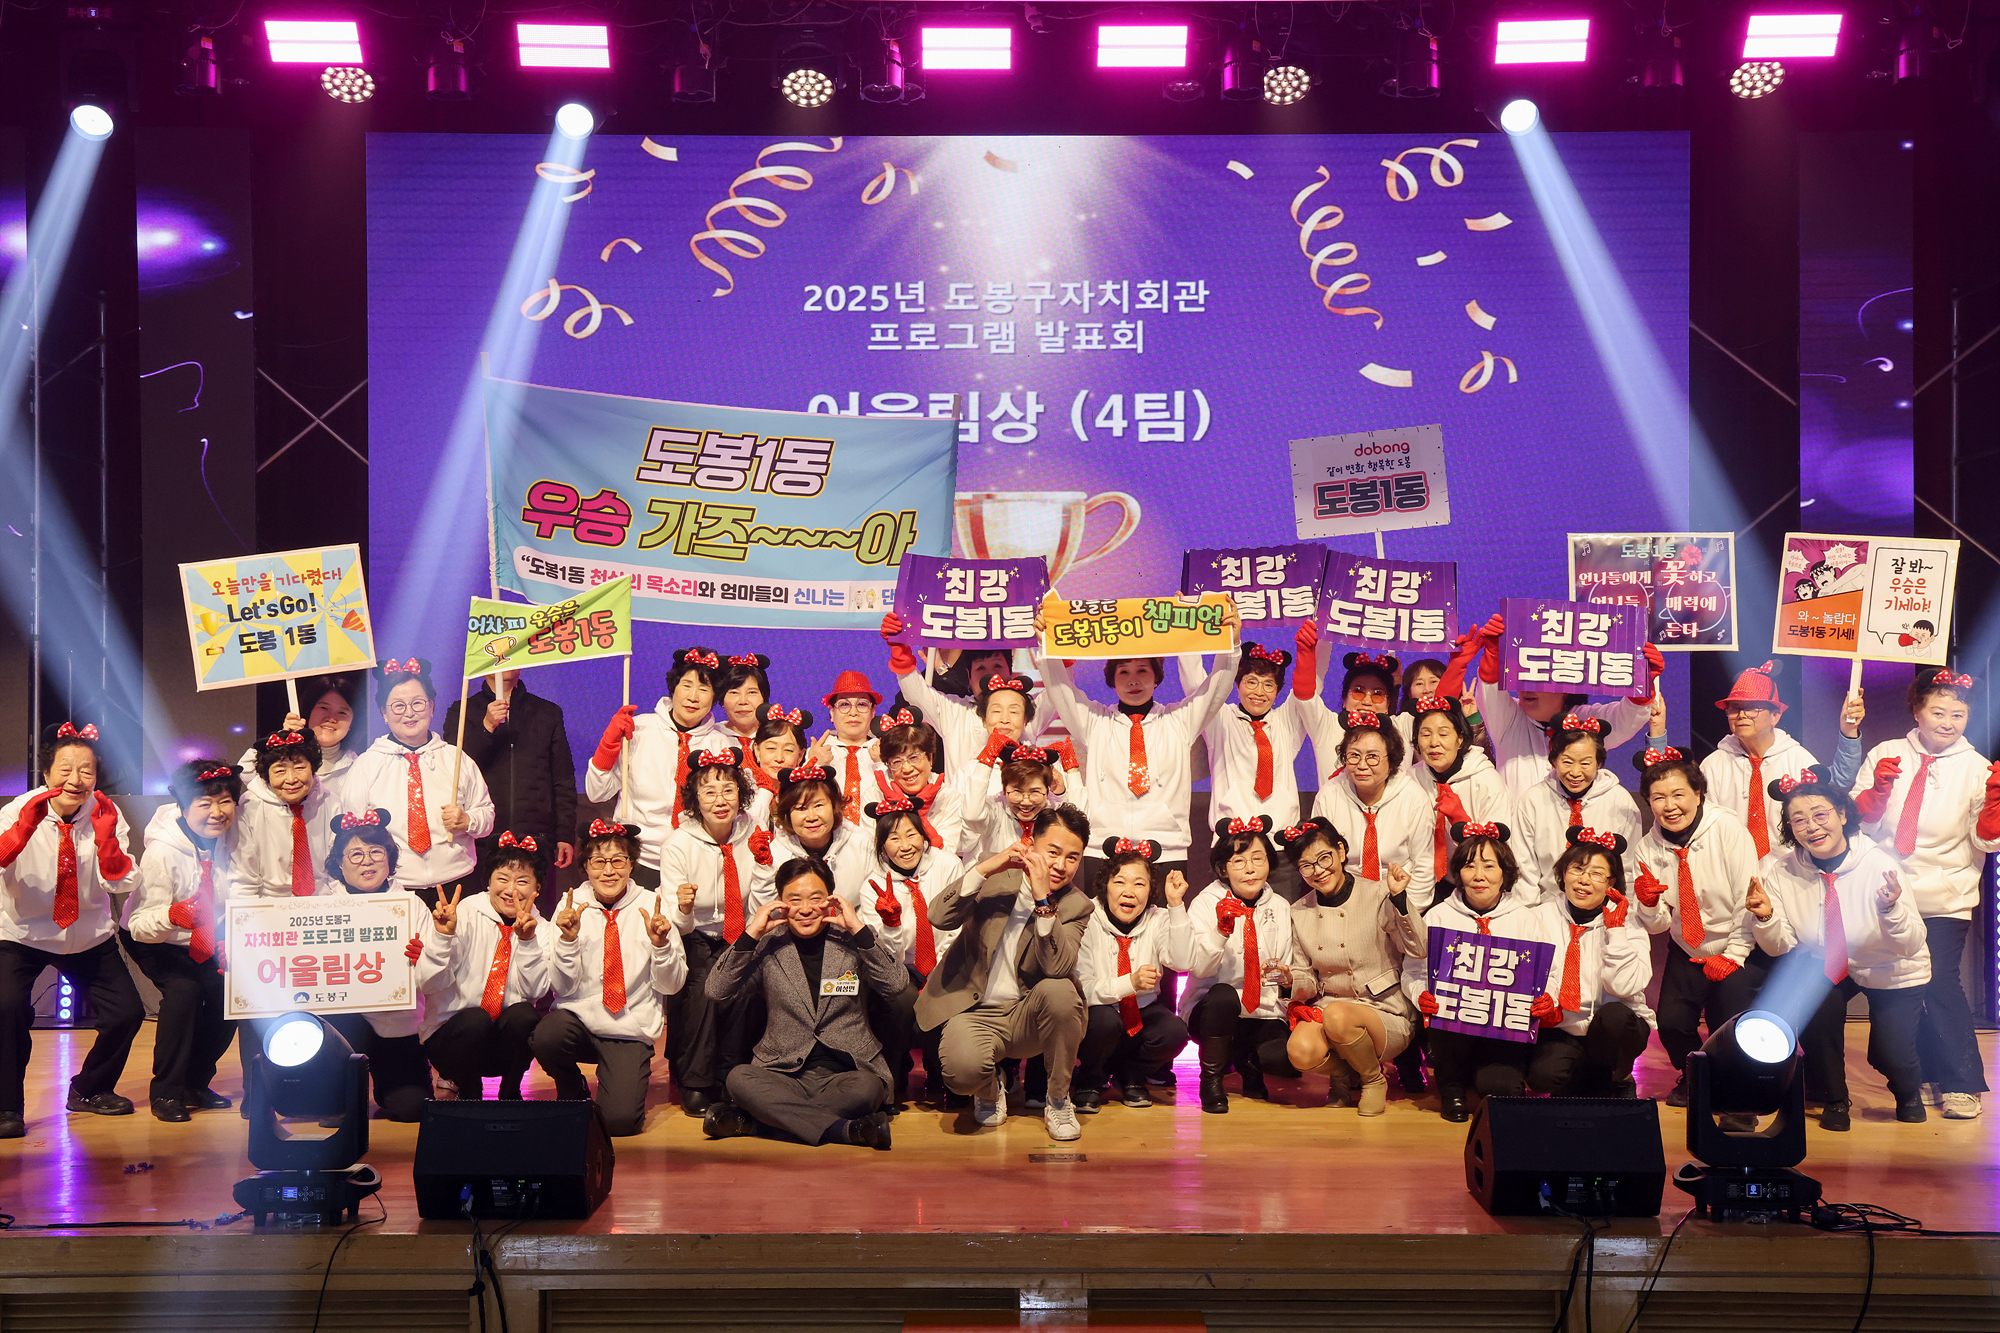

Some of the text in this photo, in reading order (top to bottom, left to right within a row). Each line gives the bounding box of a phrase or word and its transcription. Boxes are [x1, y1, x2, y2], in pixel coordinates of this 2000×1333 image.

[803, 280, 1210, 314] 2025년 도봉구자치회관
[867, 320, 1144, 354] 프로그램 발표회
[1071, 389, 1211, 443] (4팀)
[635, 426, 835, 496] 도봉1동
[1354, 442, 1410, 457] dobong
[1326, 466, 1343, 477] 같이
[1367, 458, 1394, 472] 행복한
[1397, 456, 1411, 469] 도봉
[1314, 472, 1428, 520] 도봉1동
[521, 480, 633, 548] 우승
[1621, 543, 1677, 559] 도봉1동
[1891, 558, 1907, 574] 잘
[212, 567, 343, 596] 오늘만을 기다렸다!
[647, 575, 716, 598] 목소리와
[720, 583, 789, 604] 엄마들의
[794, 587, 845, 606] 신나는
[1579, 570, 1652, 587] 언니들에게
[1889, 577, 1927, 595] 우승은
[1200, 585, 1316, 622] 봉1동
[1665, 595, 1717, 612] 매력에
[1797, 610, 1809, 622] 와
[1822, 611, 1857, 626] 놀랍다
[1884, 596, 1931, 613] 기세야!
[528, 610, 617, 655] 도봉1동
[919, 604, 1036, 641] 도봉1동
[1053, 599, 1224, 648] 도봉1동이 챔피언
[1326, 599, 1446, 643] 도봉1동
[1665, 622, 1700, 638] 든다
[1787, 625, 1855, 641] 도봉1동 기세!
[1517, 646, 1634, 686] 도봉1동
[289, 914, 351, 927] 2025년 도봉구
[244, 925, 398, 948] 자치회관 프로그램 발표회
[257, 951, 386, 989] 어울림상
[314, 991, 348, 1003] 도봉구
[1433, 981, 1535, 1031] 도봉1동
